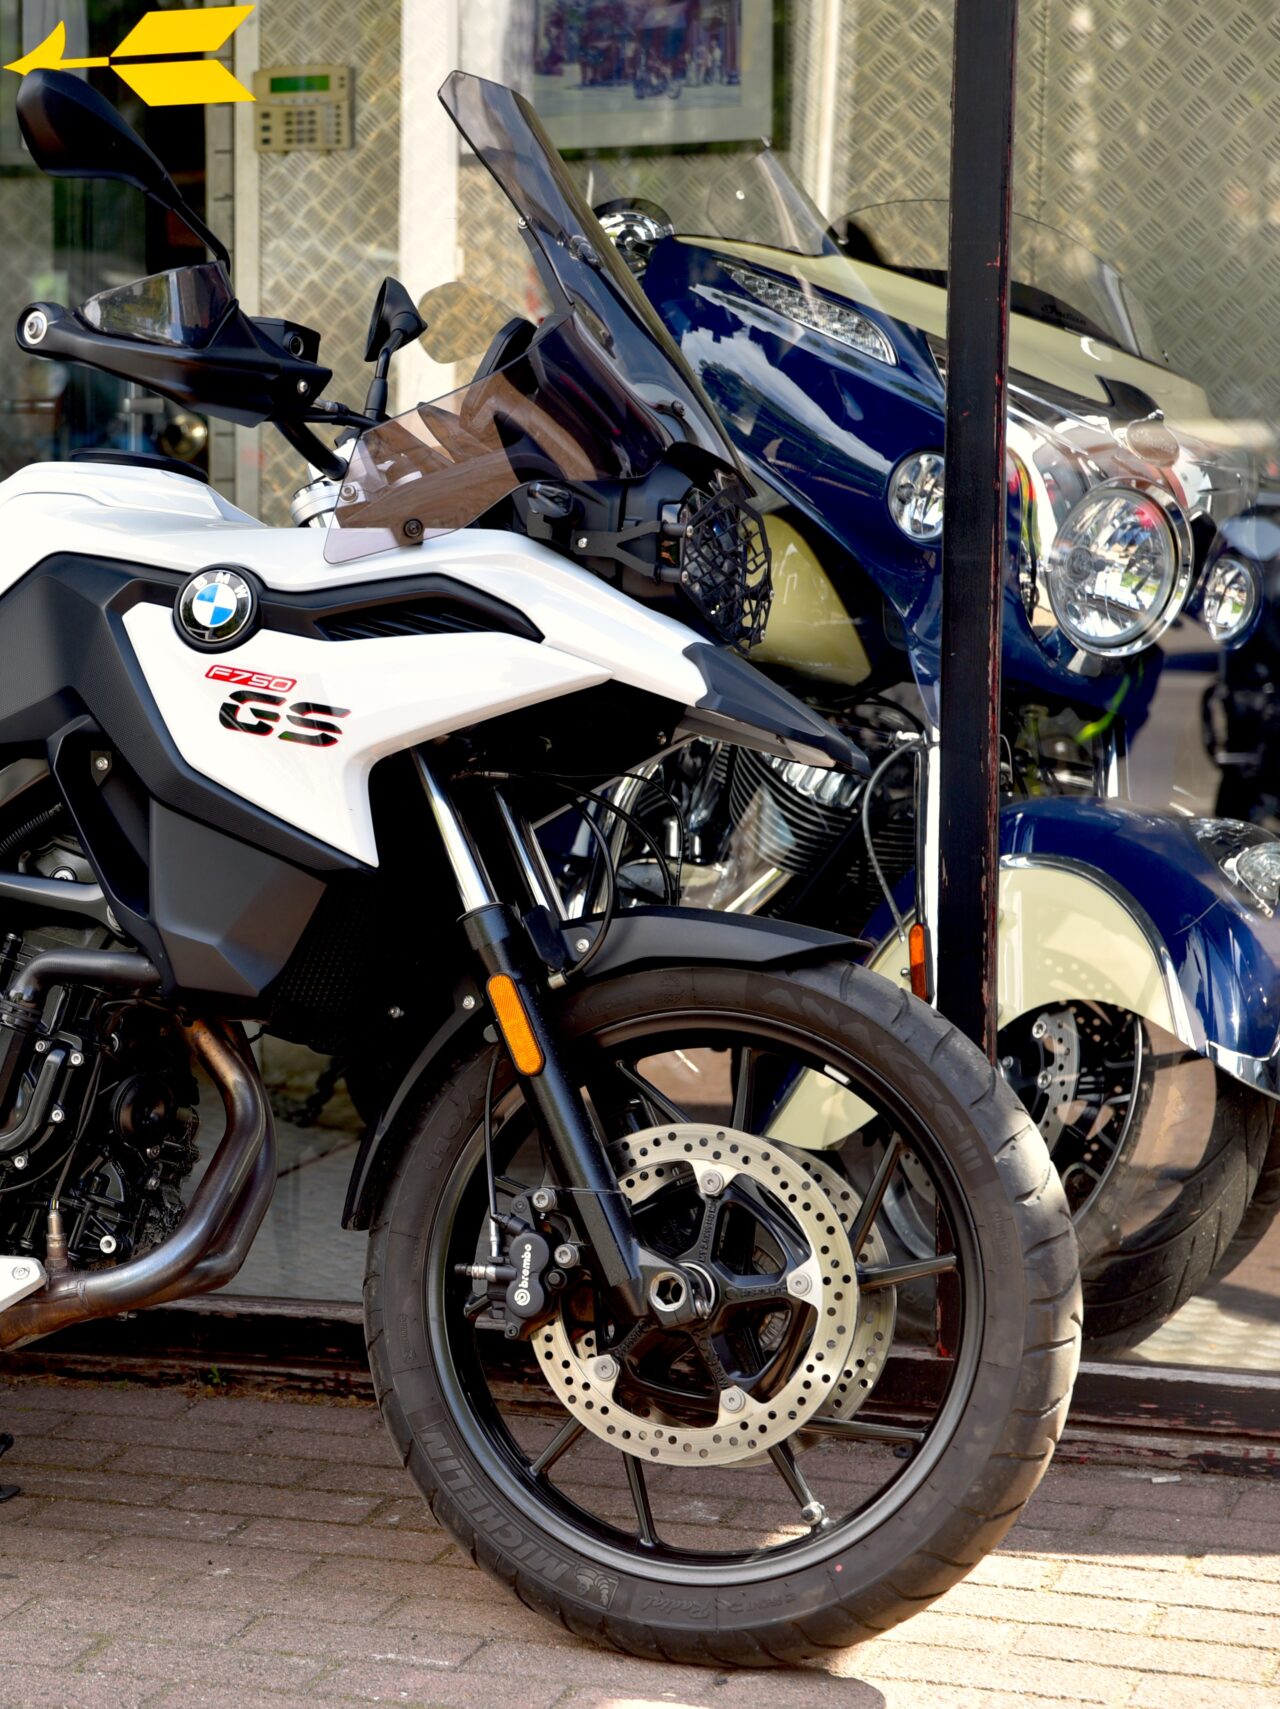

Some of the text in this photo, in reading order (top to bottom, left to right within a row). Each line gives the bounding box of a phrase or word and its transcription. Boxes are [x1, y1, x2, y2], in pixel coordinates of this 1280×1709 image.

[192, 571, 249, 599] BMW
[207, 666, 296, 691] F750
[219, 690, 352, 747] GS
[518, 1243, 532, 1289] brembo
[422, 1430, 572, 1583] MICHELIN
